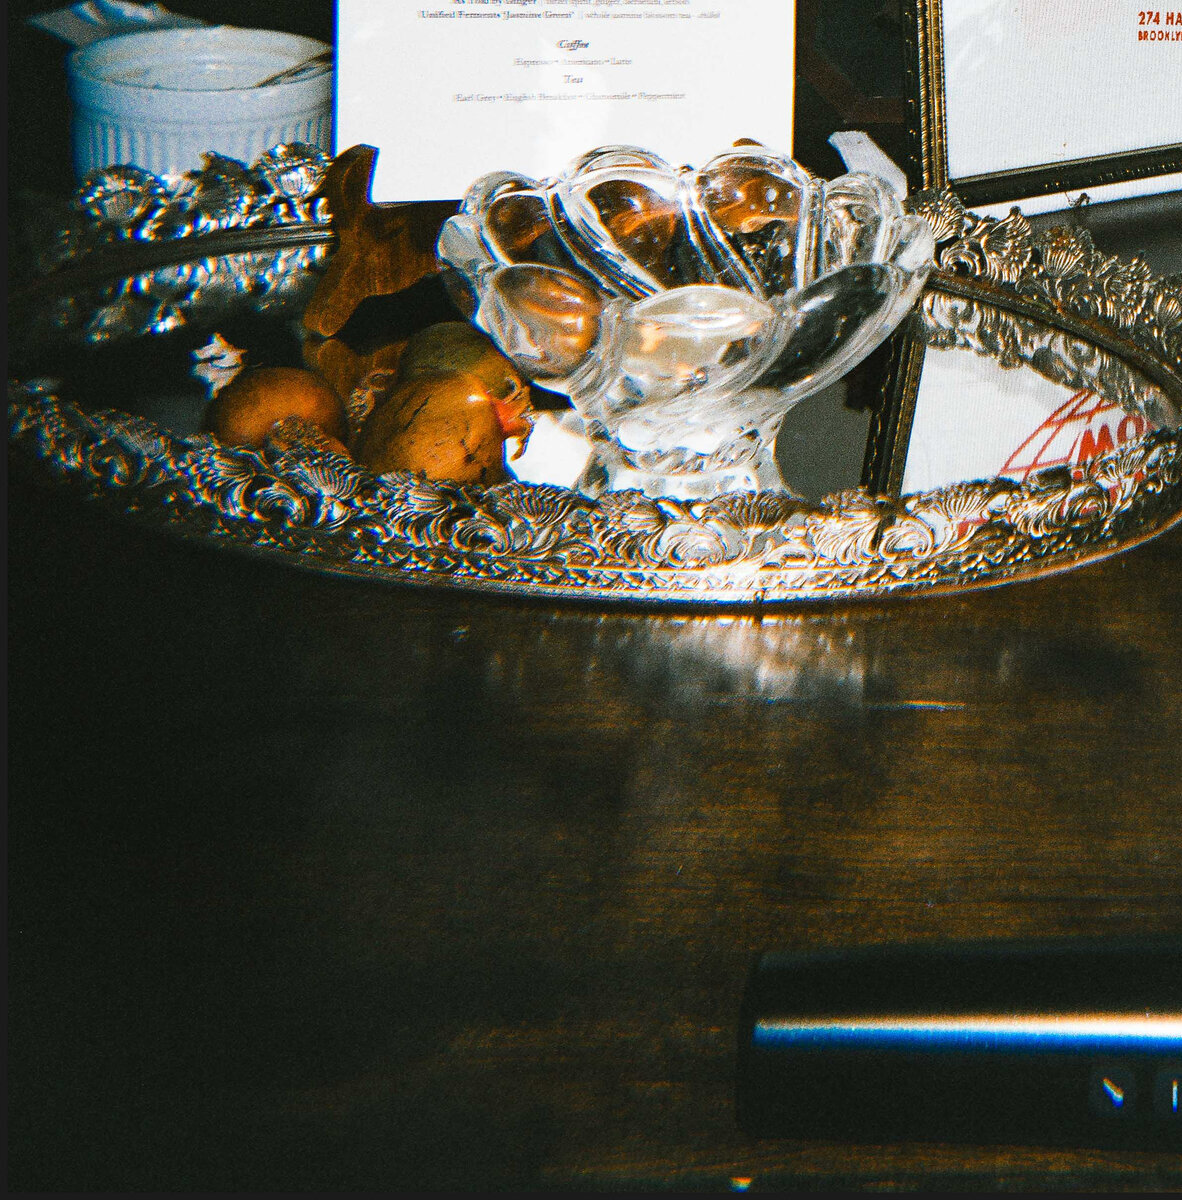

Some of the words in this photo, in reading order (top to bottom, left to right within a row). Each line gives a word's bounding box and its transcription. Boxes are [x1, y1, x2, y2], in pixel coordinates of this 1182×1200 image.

[1137, 11, 1161, 26] 274
[556, 39, 590, 51] Coffee
[563, 74, 584, 84] Tea
